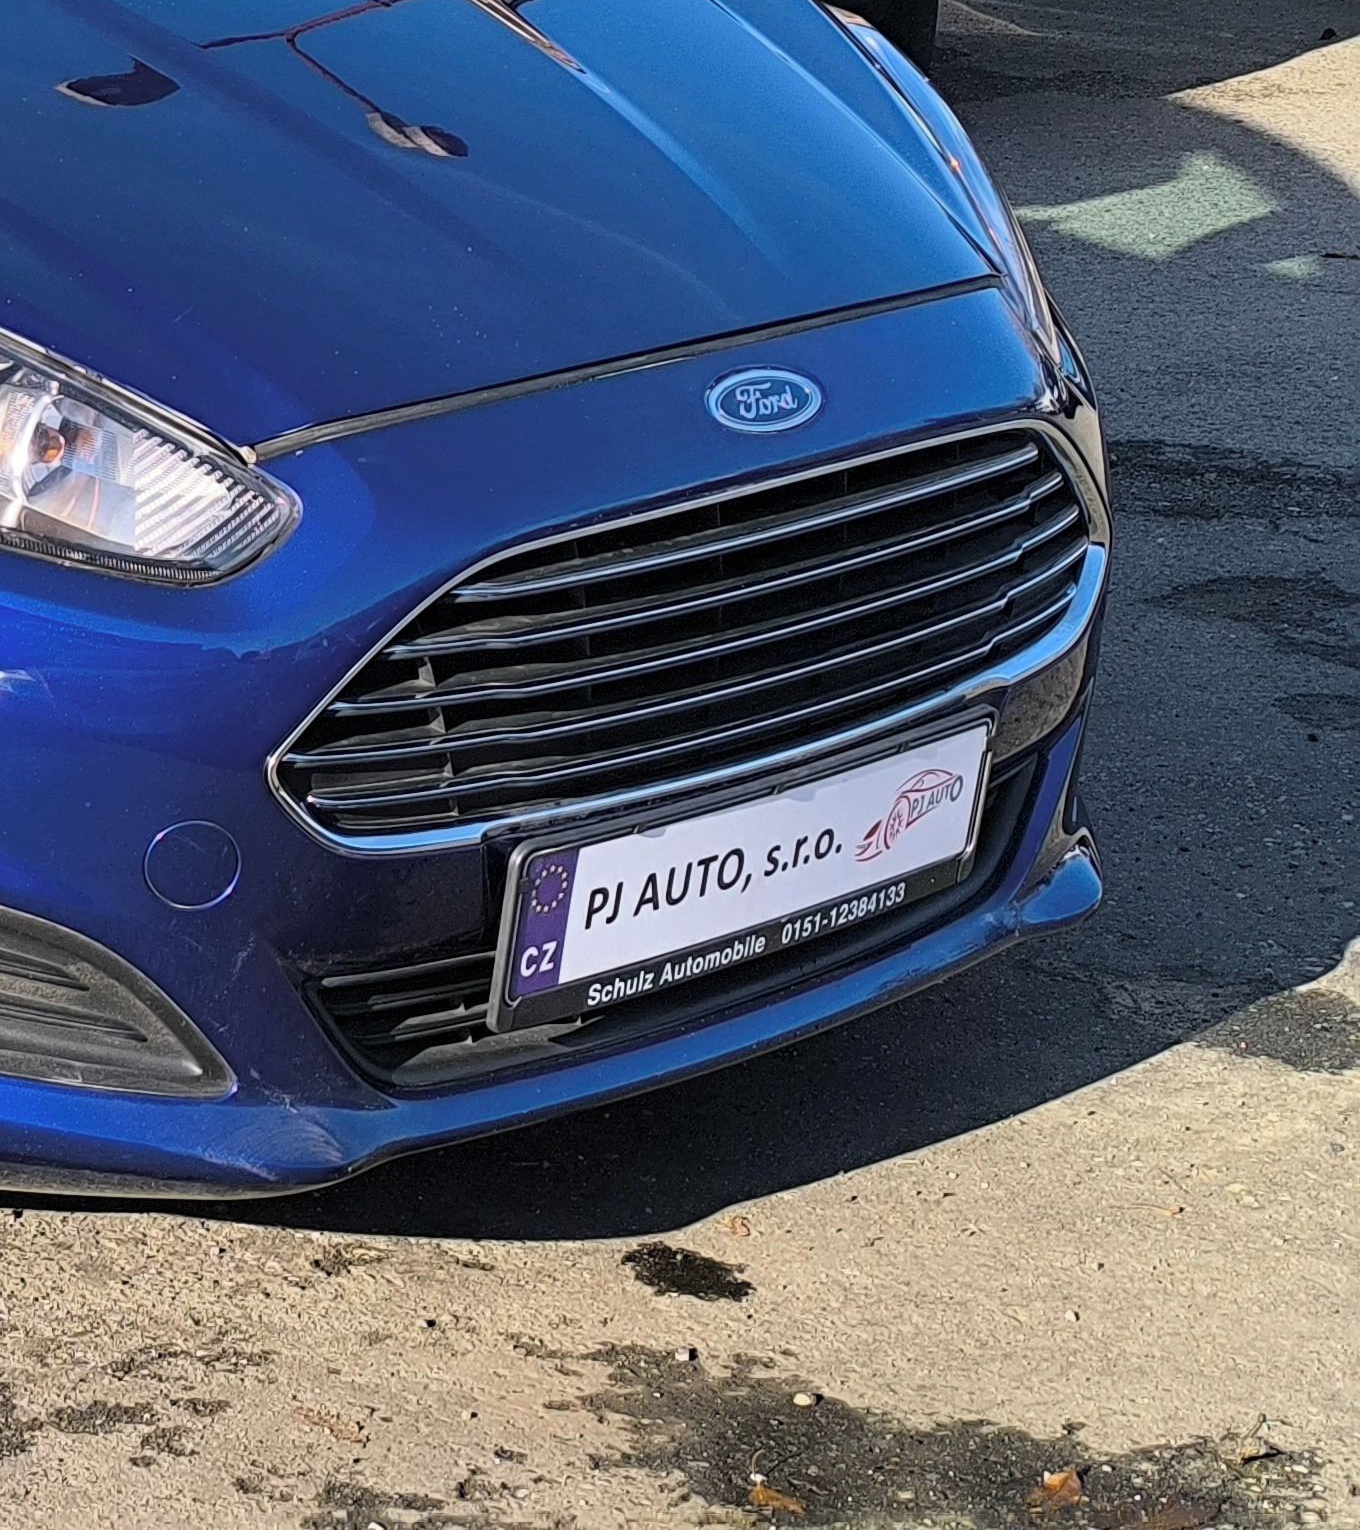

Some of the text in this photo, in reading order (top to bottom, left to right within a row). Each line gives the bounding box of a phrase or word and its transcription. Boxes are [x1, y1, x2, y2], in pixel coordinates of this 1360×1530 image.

[735, 382, 798, 419] Ford
[908, 773, 964, 818] PJ AUTO
[584, 827, 843, 931] PJ AUTO, s.r.o.
[520, 940, 559, 979] CZ
[586, 882, 907, 1007] Schulz Automobile 0151-12384133
